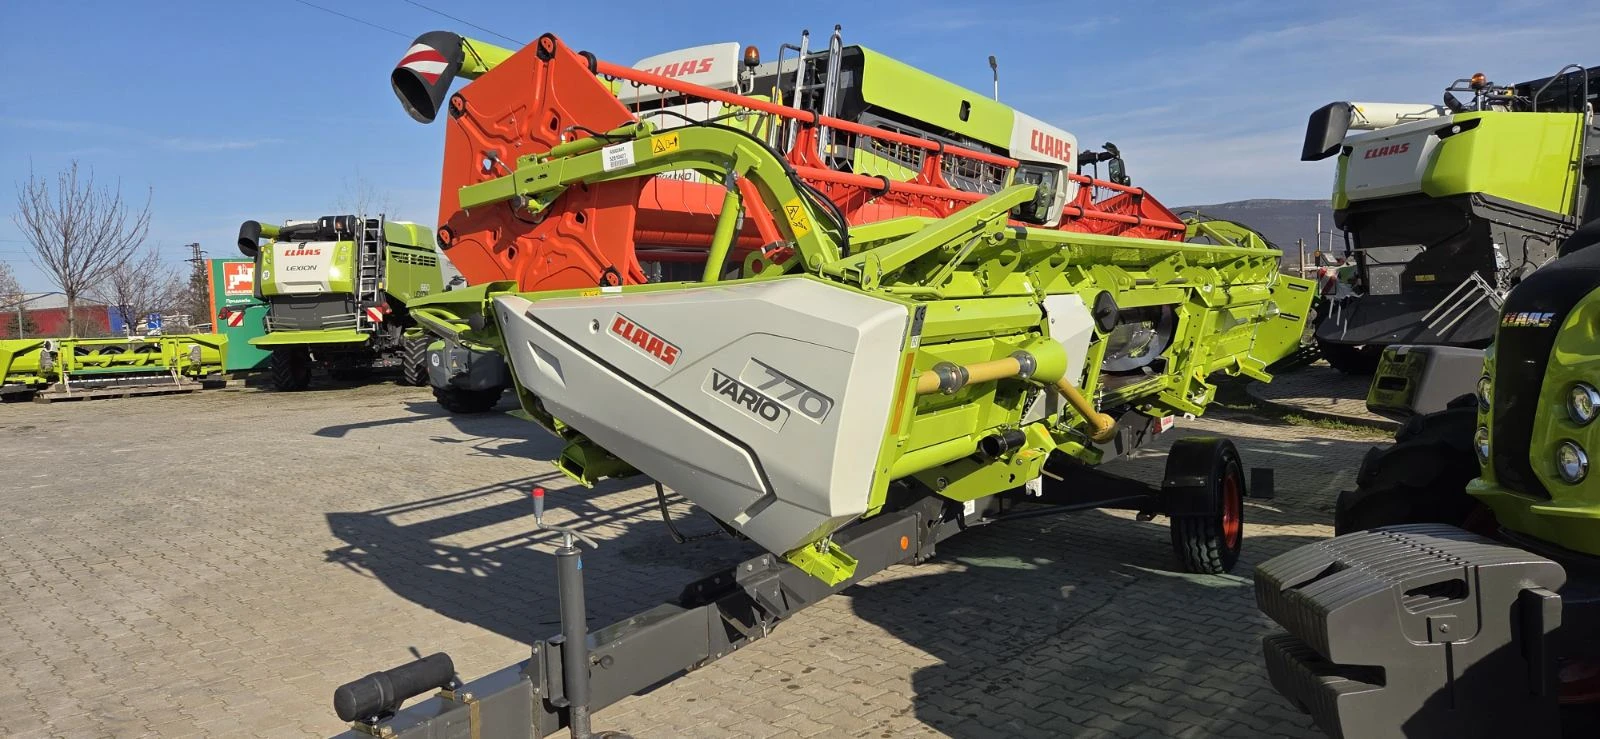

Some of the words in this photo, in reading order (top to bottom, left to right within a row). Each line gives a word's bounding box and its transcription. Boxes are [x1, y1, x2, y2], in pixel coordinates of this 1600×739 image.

[1031, 129, 1071, 163] CLAAS
[1364, 143, 1410, 159] CLAAS
[284, 249, 321, 257] CLAAS
[1501, 312, 1556, 328] CLAAS
[612, 316, 678, 366] CLAAS
[712, 372, 781, 422] VARIO
[757, 368, 829, 419] 770
